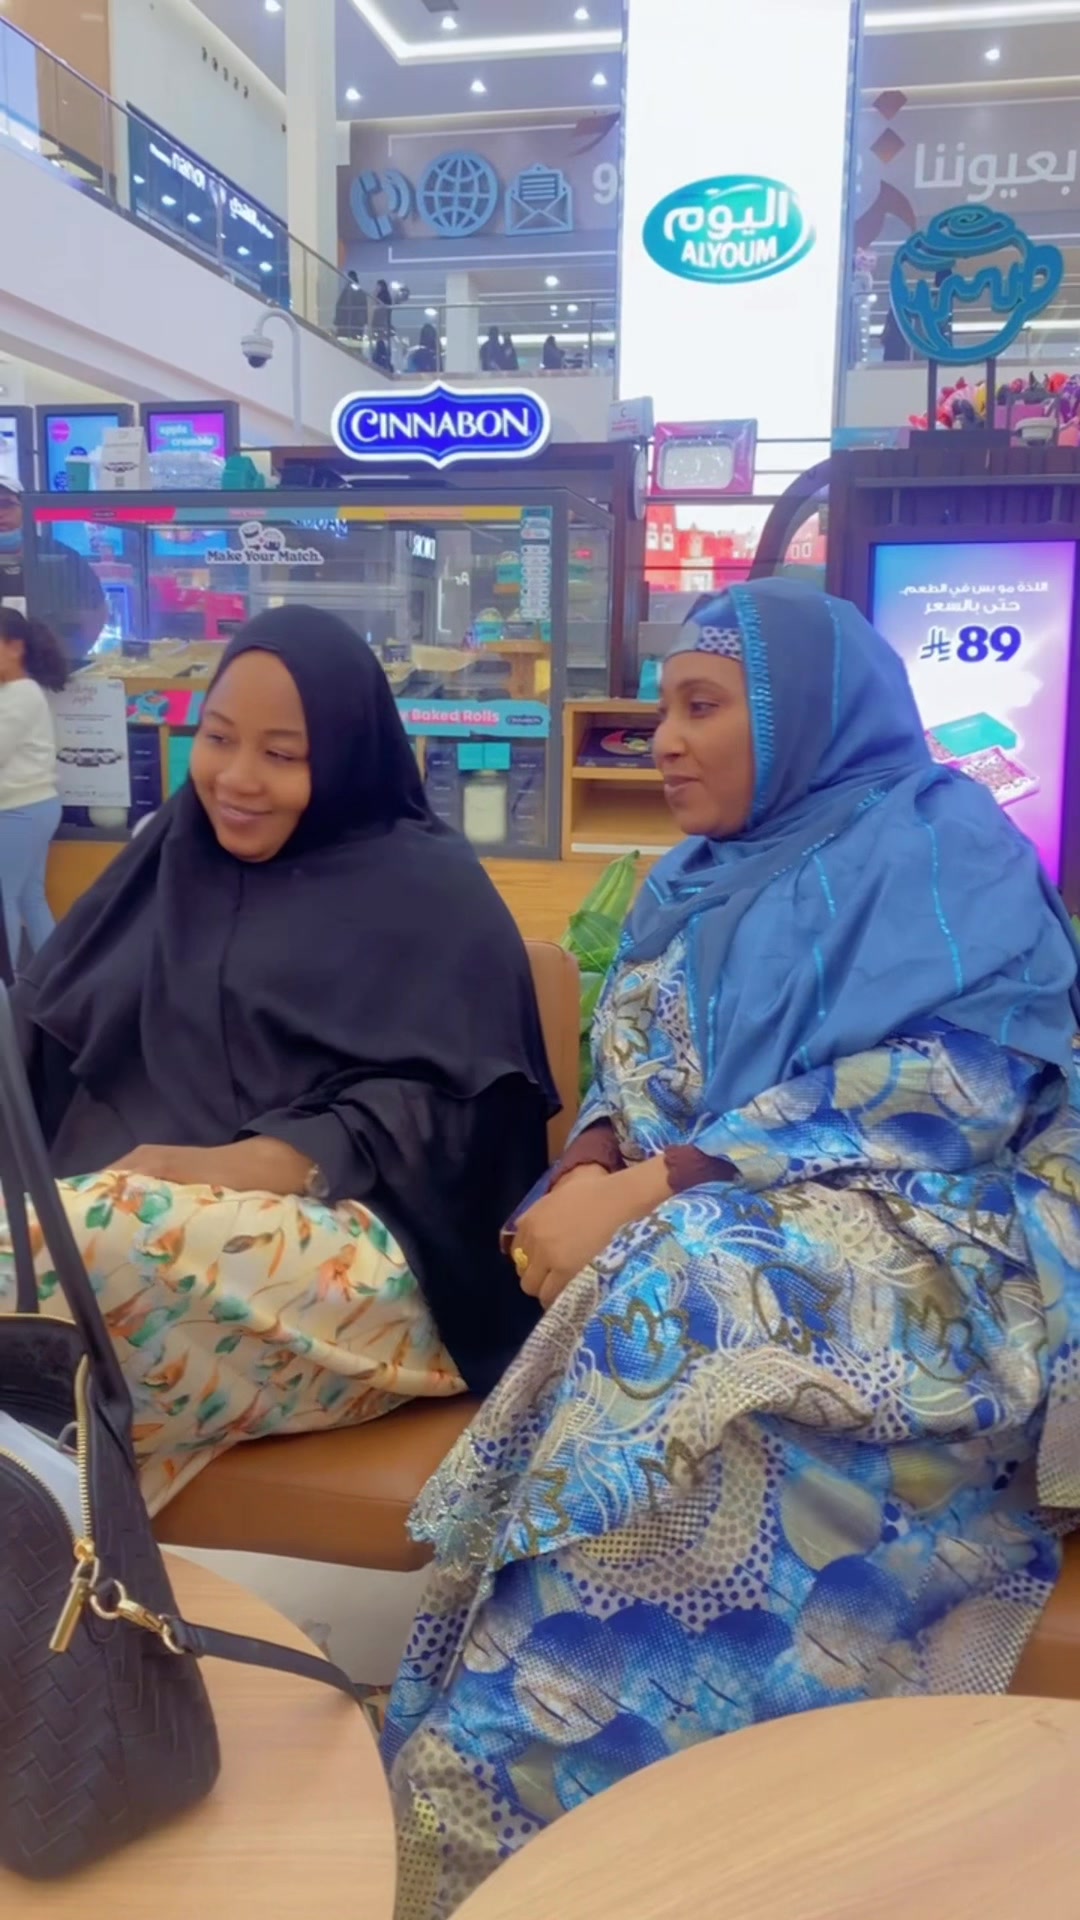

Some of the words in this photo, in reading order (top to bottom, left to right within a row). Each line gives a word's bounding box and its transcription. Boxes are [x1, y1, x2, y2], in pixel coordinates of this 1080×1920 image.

[913, 142, 1077, 202] بعيوننا
[662, 186, 789, 242] اليوم
[680, 235, 778, 269] ALYOUM
[351, 407, 529, 442] CINNABON
[207, 550, 241, 561] Make
[245, 551, 275, 561] Your
[924, 599, 981, 616] بالسعر
[957, 626, 1022, 663] 89
[410, 707, 459, 723] Baked
[462, 709, 500, 725] Rolls
